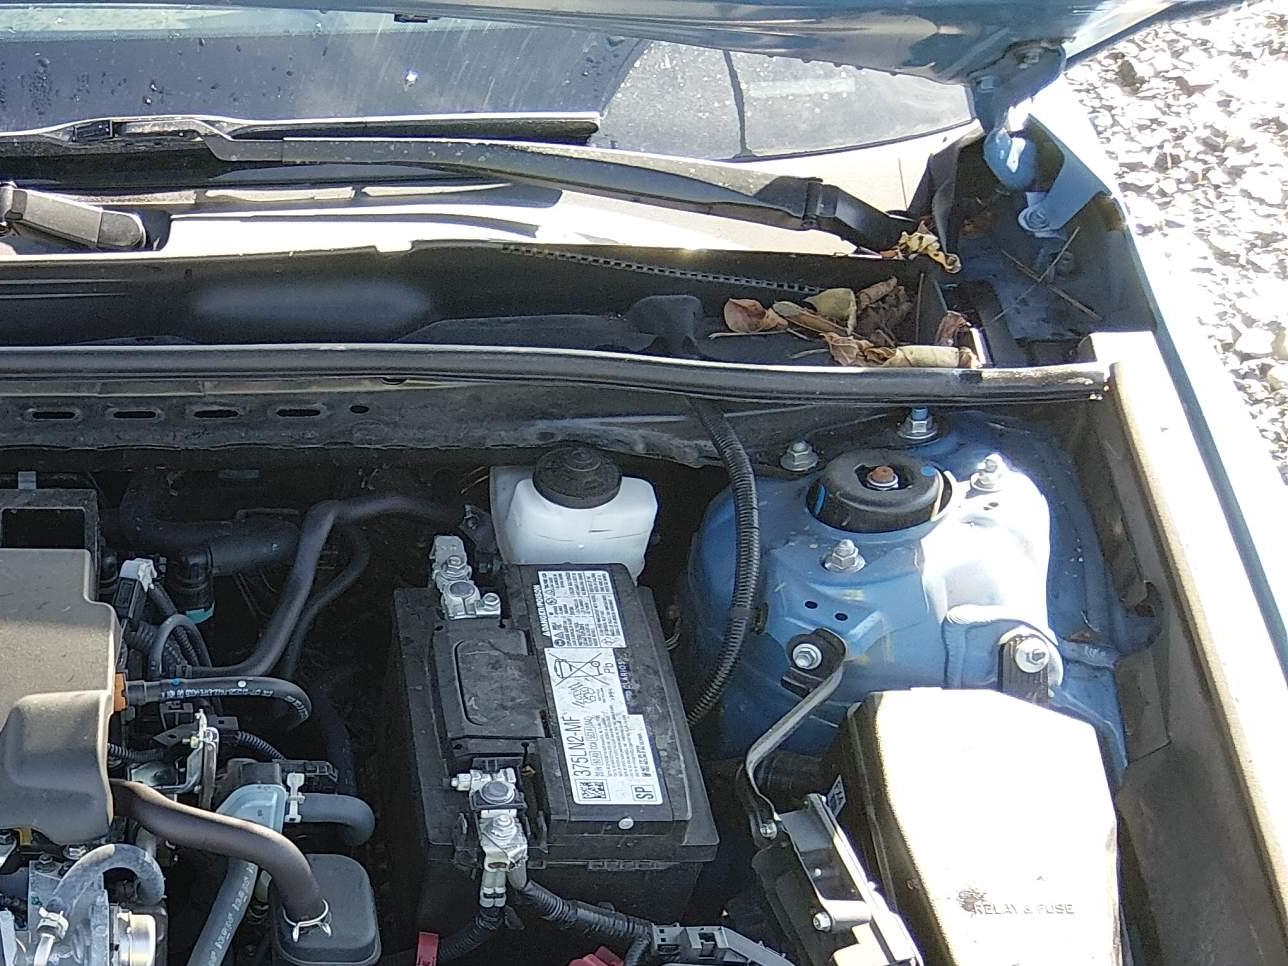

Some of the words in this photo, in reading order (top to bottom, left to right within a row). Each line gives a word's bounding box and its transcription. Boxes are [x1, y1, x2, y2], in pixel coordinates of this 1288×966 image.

[562, 716, 590, 776] 375LN2-MF
[635, 787, 653, 798] SP
[974, 904, 1017, 915] RELAY
[1038, 904, 1074, 915] FUSE
